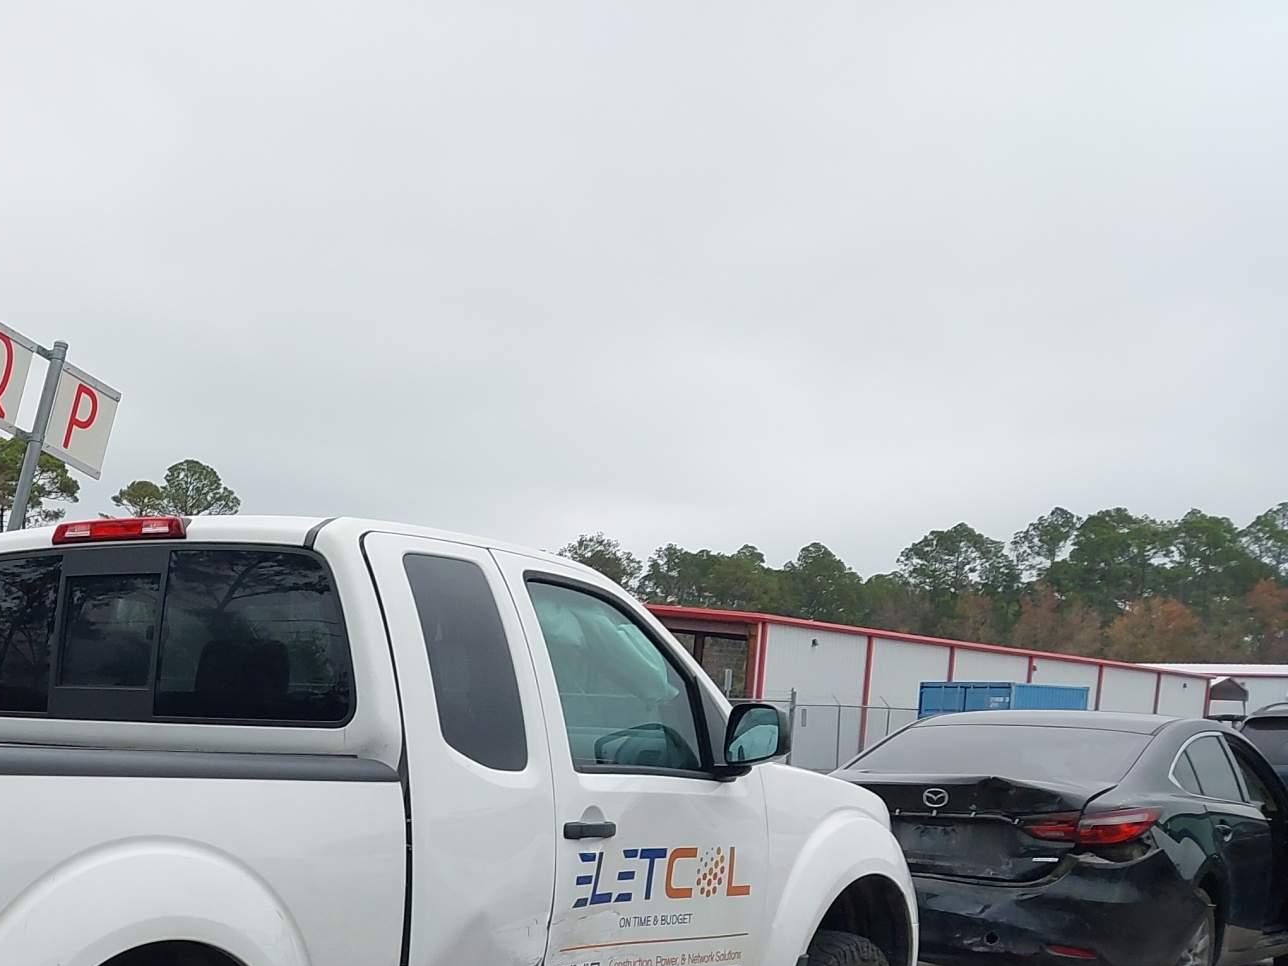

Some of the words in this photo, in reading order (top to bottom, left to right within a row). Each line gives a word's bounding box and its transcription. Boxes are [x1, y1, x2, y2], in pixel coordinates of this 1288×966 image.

[63, 383, 98, 449] P
[572, 847, 751, 908] ELETCOL
[619, 916, 631, 928] ON
[632, 914, 651, 927] TIME
[652, 914, 659, 926] &
[660, 913, 693, 926] BUDGET
[680, 953, 686, 966] &
[687, 952, 716, 965] Network
[715, 950, 742, 963] Solutions
